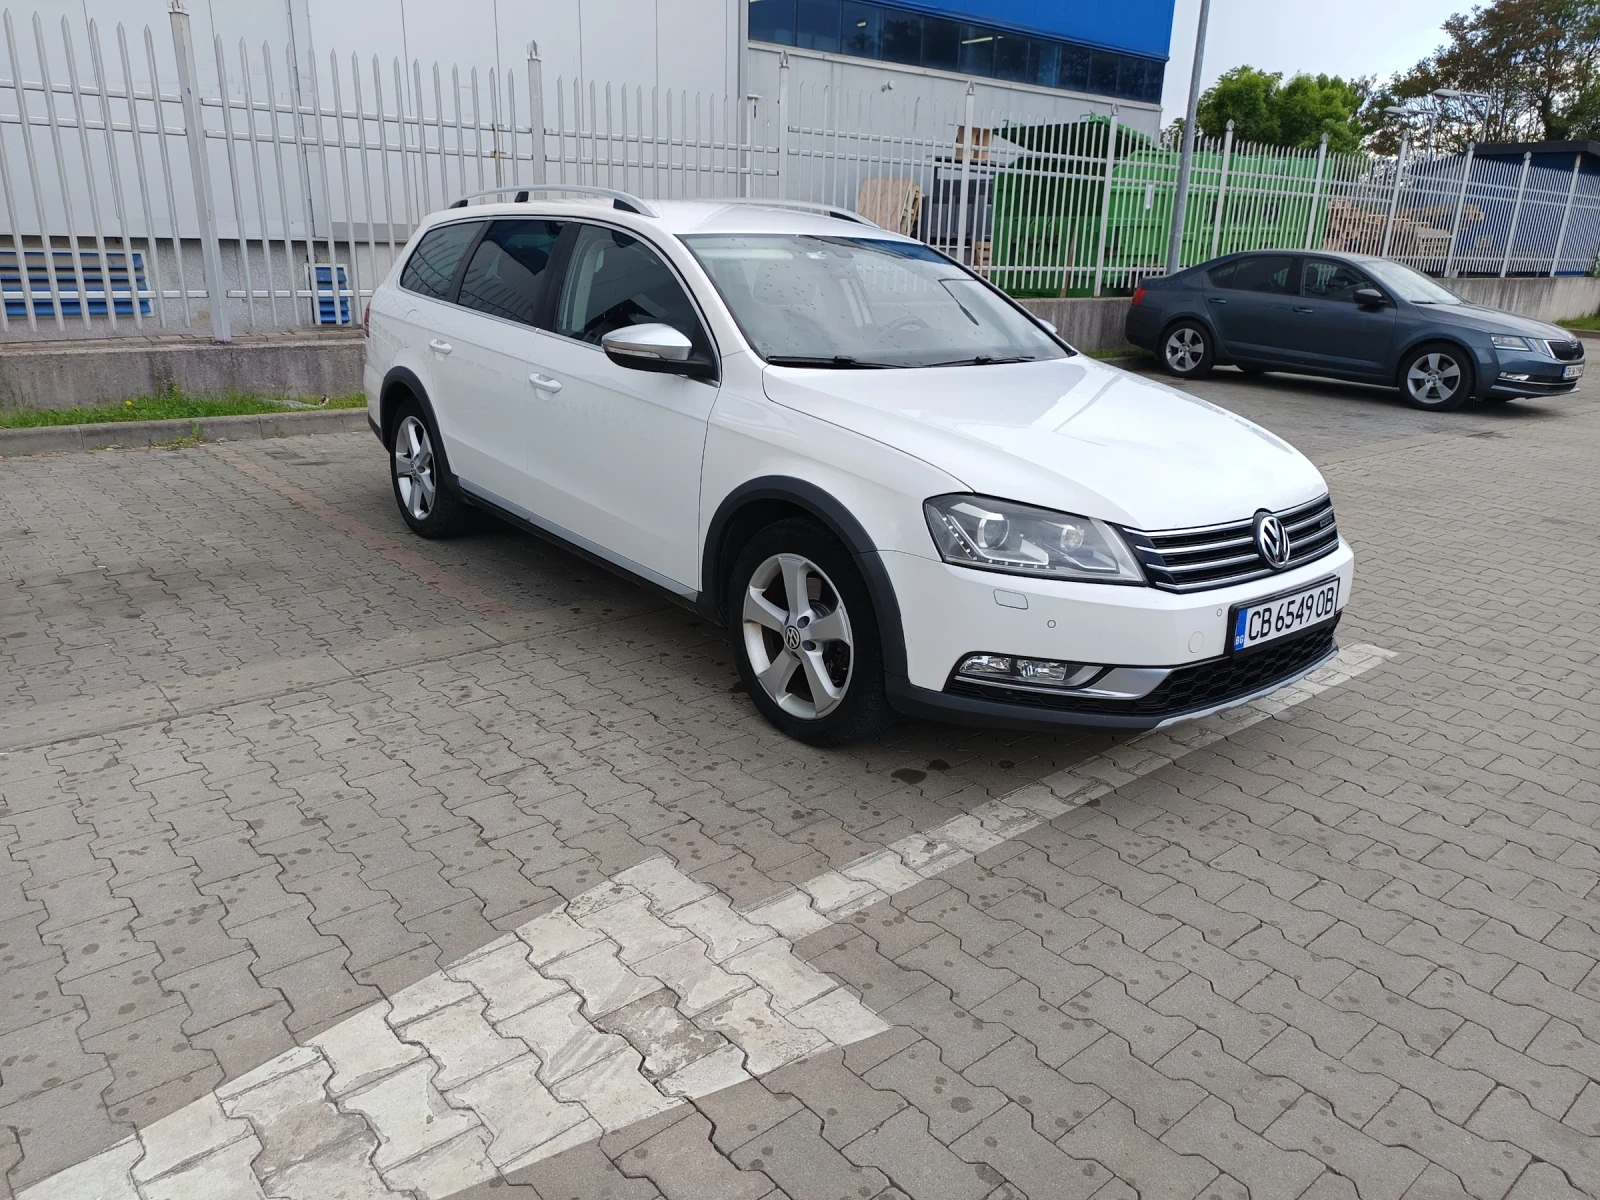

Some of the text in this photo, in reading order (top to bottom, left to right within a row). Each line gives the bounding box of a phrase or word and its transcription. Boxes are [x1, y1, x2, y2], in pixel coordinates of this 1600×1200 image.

[1248, 586, 1334, 641] CB 6549 OB
[1235, 635, 1244, 645] BG
